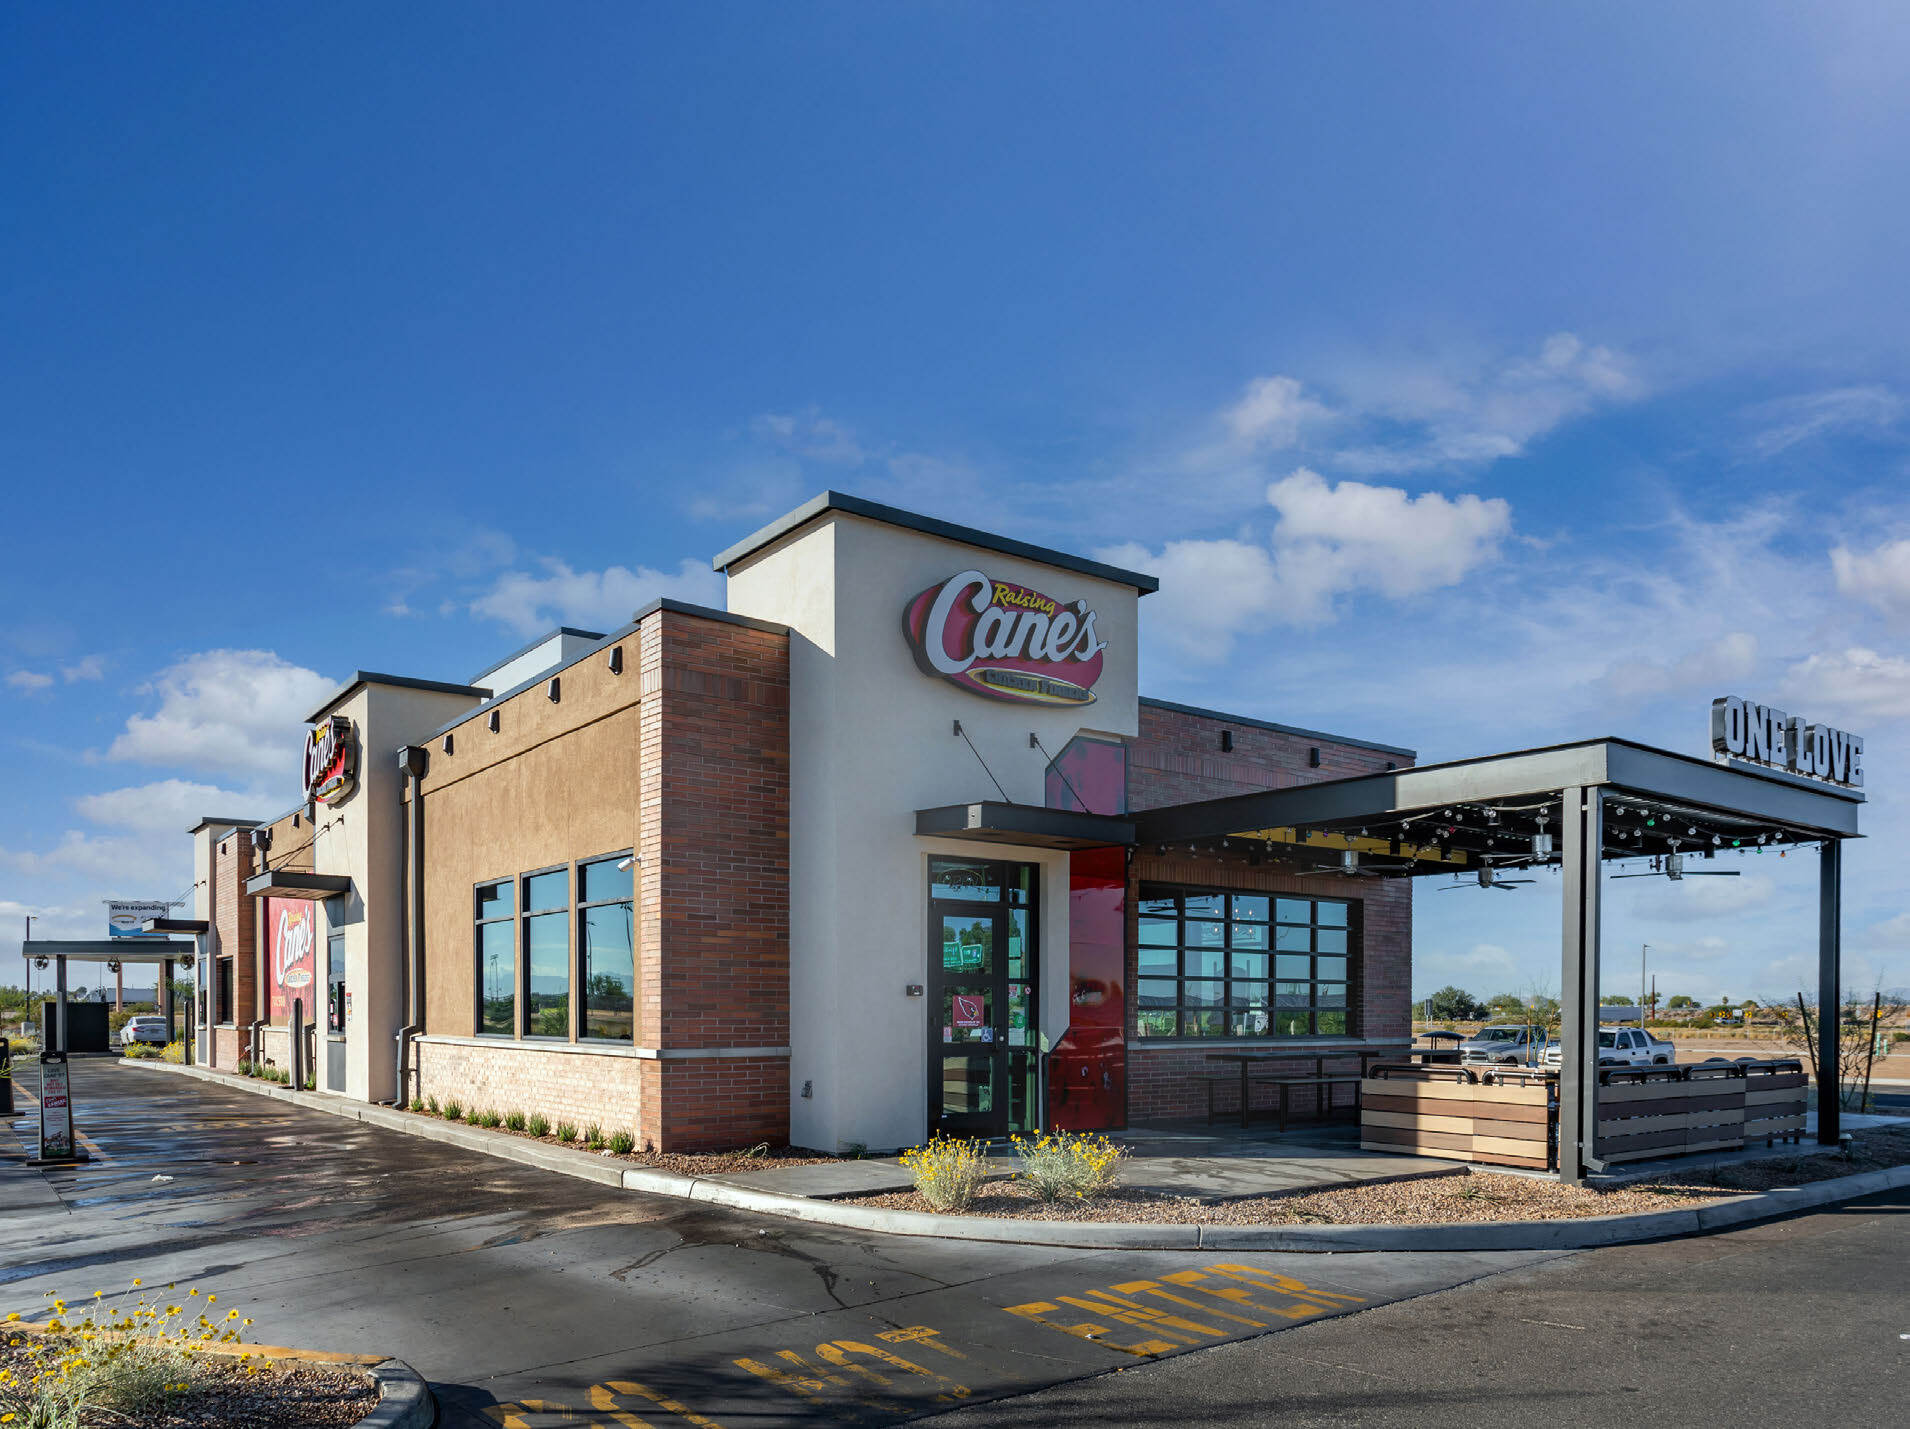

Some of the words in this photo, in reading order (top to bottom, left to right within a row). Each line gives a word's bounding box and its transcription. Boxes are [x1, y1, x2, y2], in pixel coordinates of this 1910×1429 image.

[926, 570, 1109, 674] Cane's
[991, 583, 1056, 618] Raising
[1713, 696, 1787, 768] ONE
[1788, 717, 1864, 787] LOVE
[130, 904, 166, 912] expanding
[276, 905, 313, 986] Cane's
[1002, 1263, 1367, 1357] ENTER
